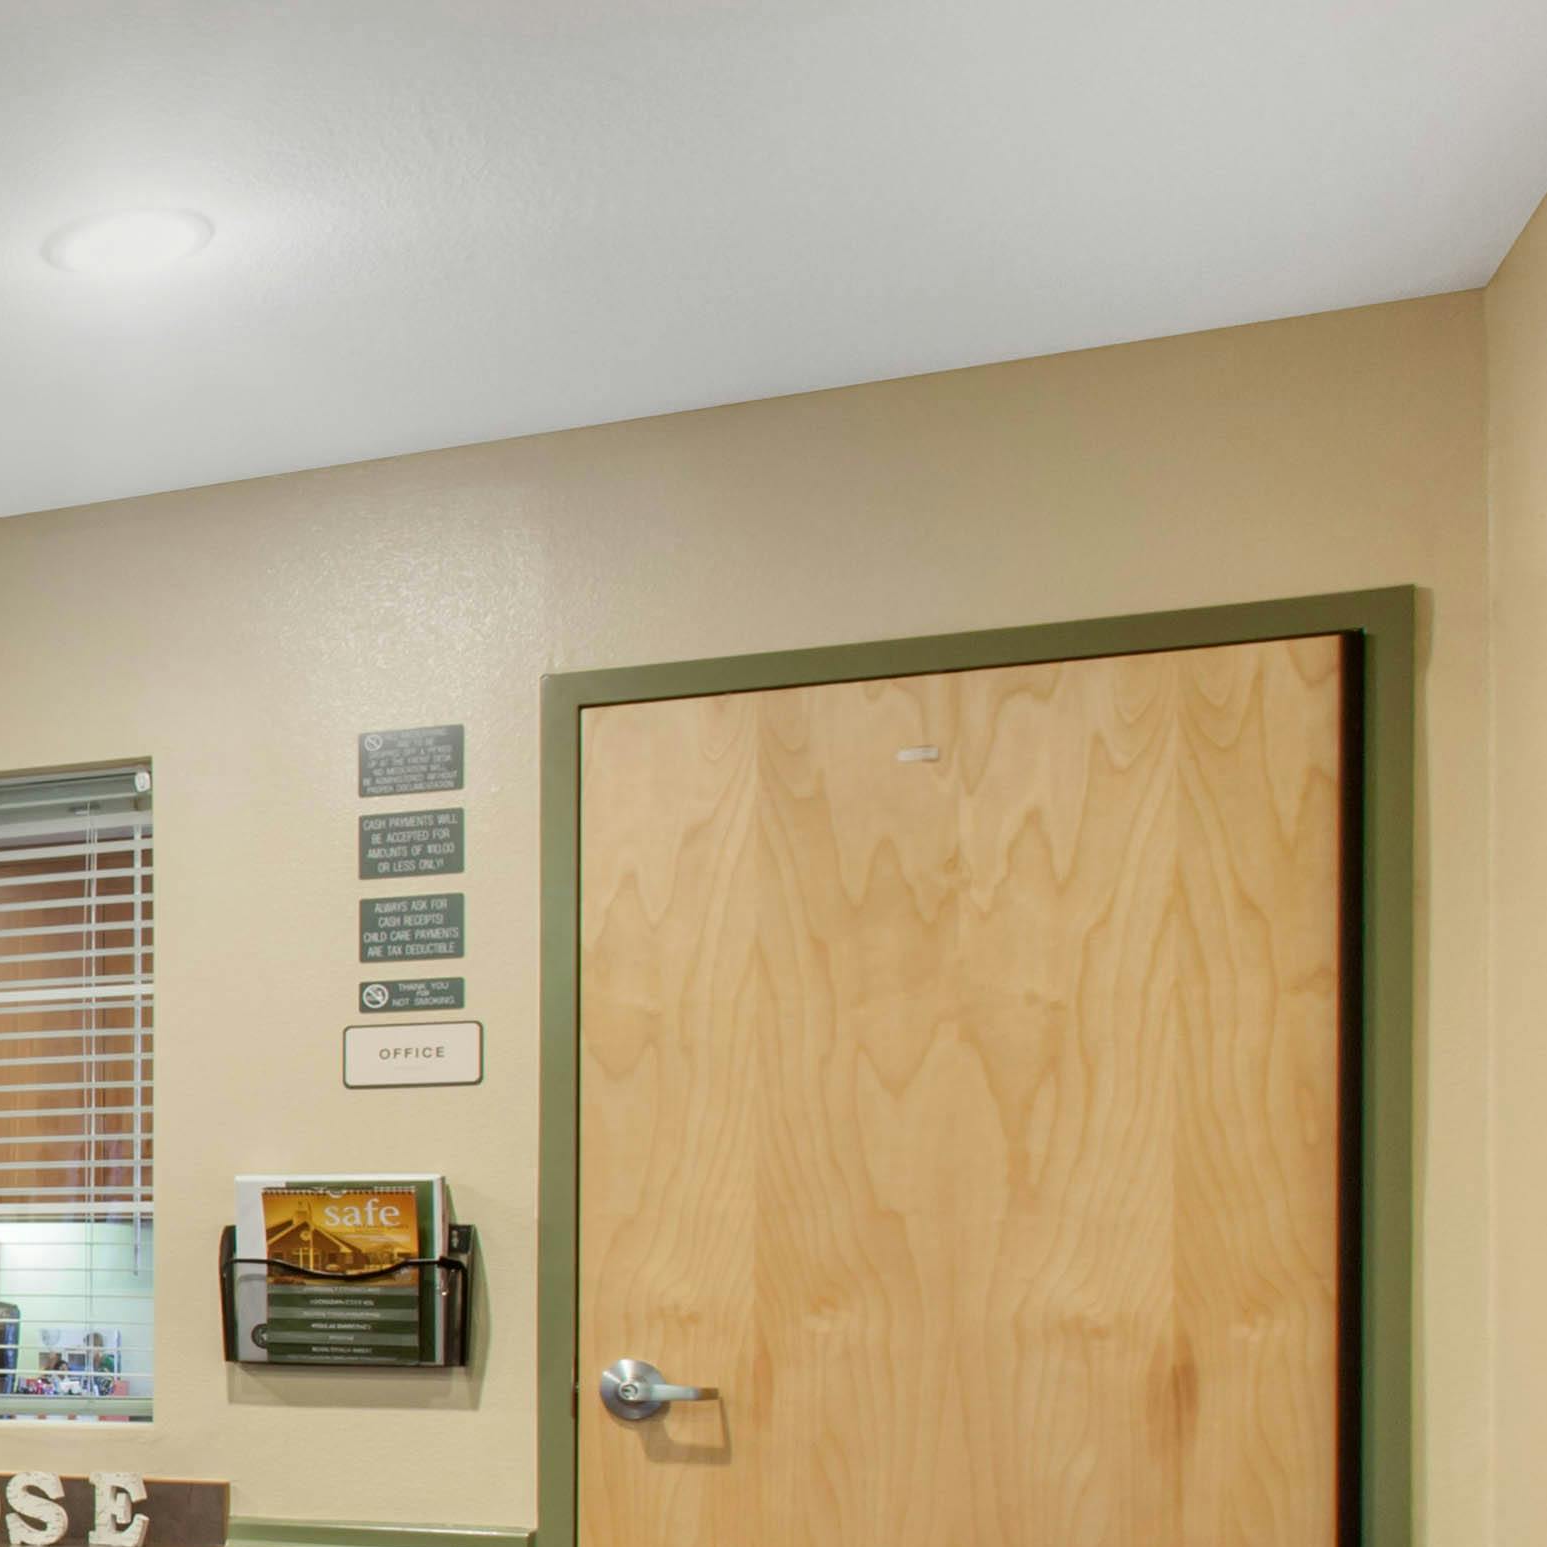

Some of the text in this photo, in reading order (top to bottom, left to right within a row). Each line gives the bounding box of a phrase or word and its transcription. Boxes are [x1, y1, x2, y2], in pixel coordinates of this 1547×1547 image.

[363, 813, 458, 831] CASH PAYMENTS WILL
[371, 828, 450, 845] BE ACCEPTED FOR
[367, 846, 408, 858] AMOUNTS
[411, 844, 423, 856] OF
[377, 861, 390, 873] OR
[392, 860, 416, 872] LESS
[375, 898, 447, 913] ALWAYS ASK FOR
[378, 916, 401, 928] CASH
[363, 927, 459, 943] CHILD CARE PAYMENTS
[367, 941, 455, 958] ARE TAX DEDUCTIBLE
[431, 981, 449, 990] YOU
[378, 1046, 446, 1061] OFFICE
[323, 1198, 401, 1227] safe
